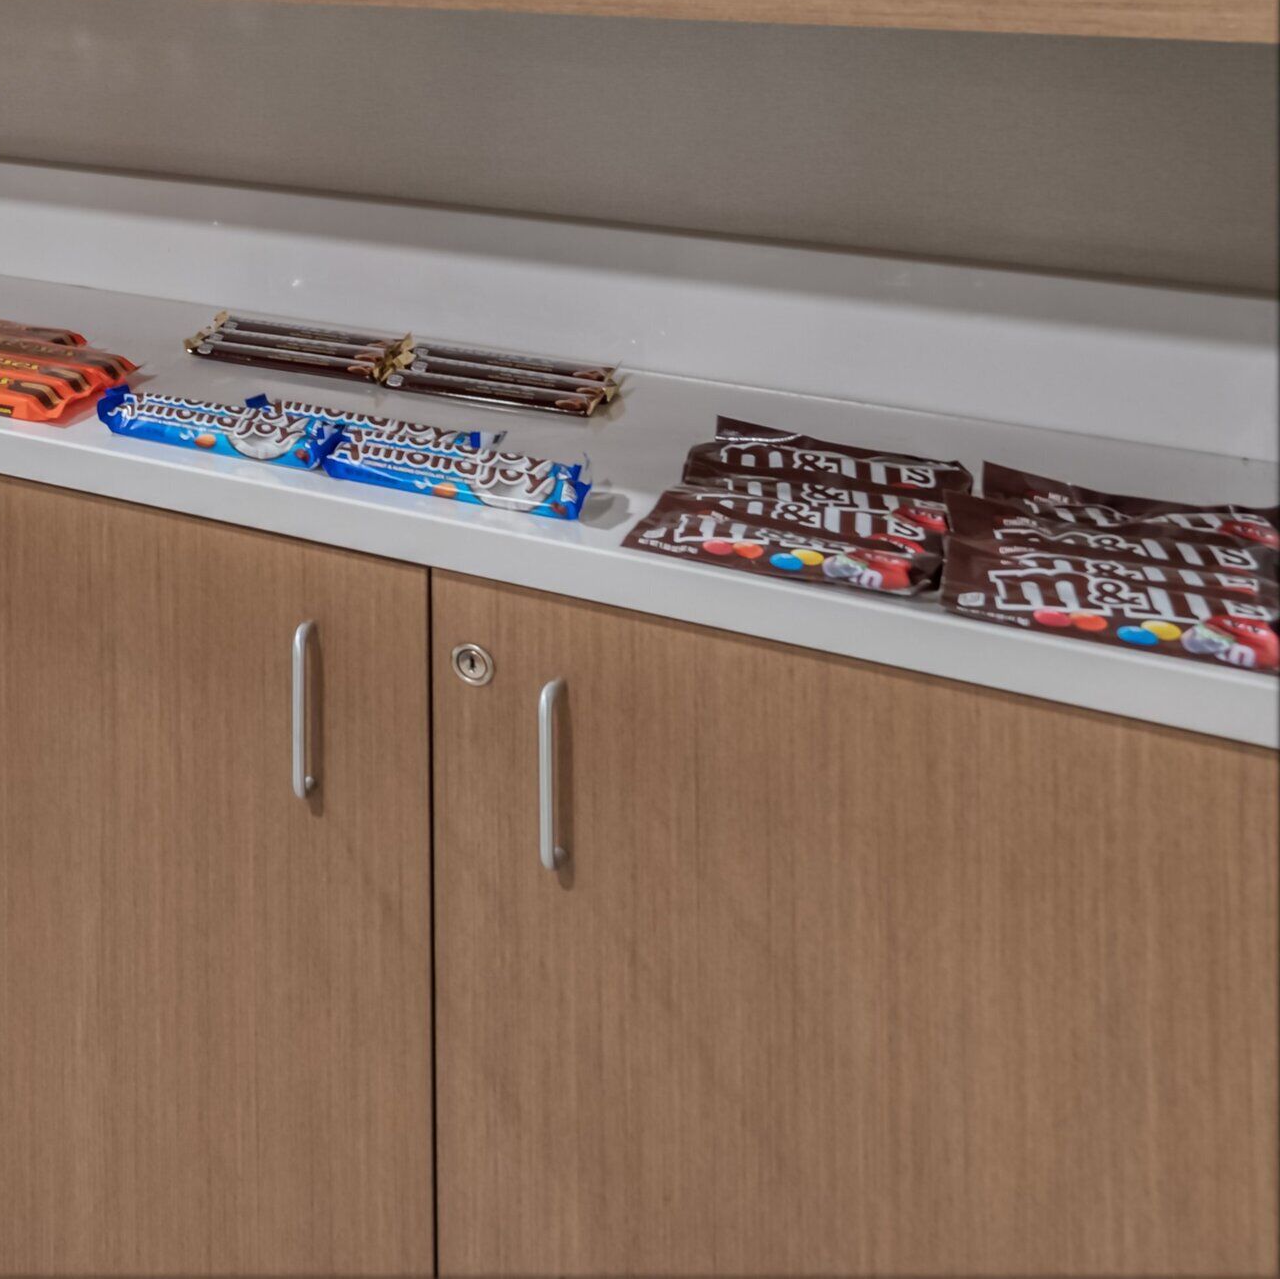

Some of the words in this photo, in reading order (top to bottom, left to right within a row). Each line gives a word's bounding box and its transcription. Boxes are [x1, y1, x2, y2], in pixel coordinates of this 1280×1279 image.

[108, 402, 239, 431] Almond
[335, 441, 480, 476] Almond
[478, 462, 554, 495] Joy
